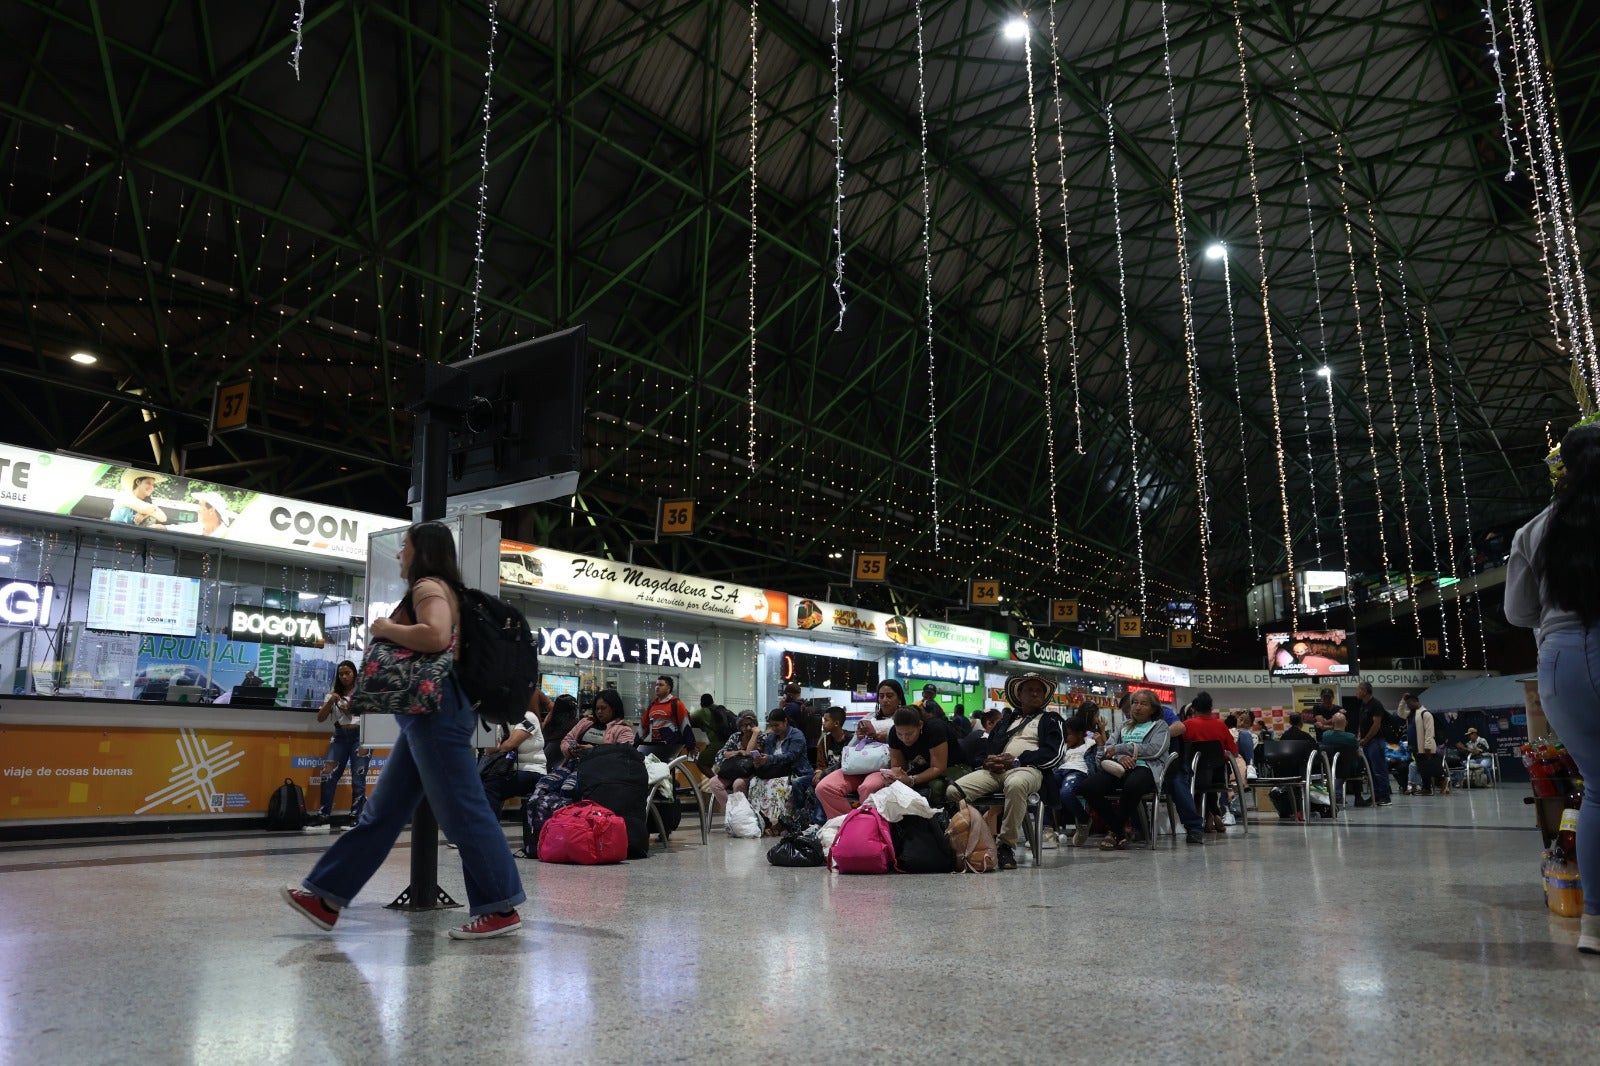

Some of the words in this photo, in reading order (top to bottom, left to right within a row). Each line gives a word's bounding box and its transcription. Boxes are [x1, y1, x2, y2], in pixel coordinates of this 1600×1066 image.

[222, 393, 243, 419] 37
[666, 507, 688, 526] 36
[862, 560, 881, 573] 35
[571, 558, 617, 582] Flota
[622, 567, 707, 598] Magdalena
[711, 585, 741, 604] S.A.
[976, 587, 995, 599] 34
[636, 591, 645, 600] A
[645, 594, 654, 602] su
[656, 595, 685, 607] servicio
[686, 601, 699, 610] por
[701, 602, 734, 615] Colombia
[1057, 605, 1074, 616] 33
[232, 611, 323, 640] BOGOTA
[832, 616, 877, 631] TOLIMA
[1123, 622, 1137, 631] 32
[1176, 634, 1187, 643] 31
[646, 638, 702, 668] FACA
[1033, 641, 1073, 667] Cootrayal
[1427, 642, 1437, 652] 29
[911, 658, 930, 676] San
[931, 660, 958, 679] Pedro
[1193, 674, 1251, 684] TERMINAL
[1254, 674, 1276, 684] DEL
[1322, 675, 1375, 684] MARIANO
[1378, 674, 1419, 684] OSPINA
[3, 766, 33, 779] viaje
[37, 766, 52, 776] de
[55, 768, 89, 777] cosas
[92, 766, 134, 777] buenas
